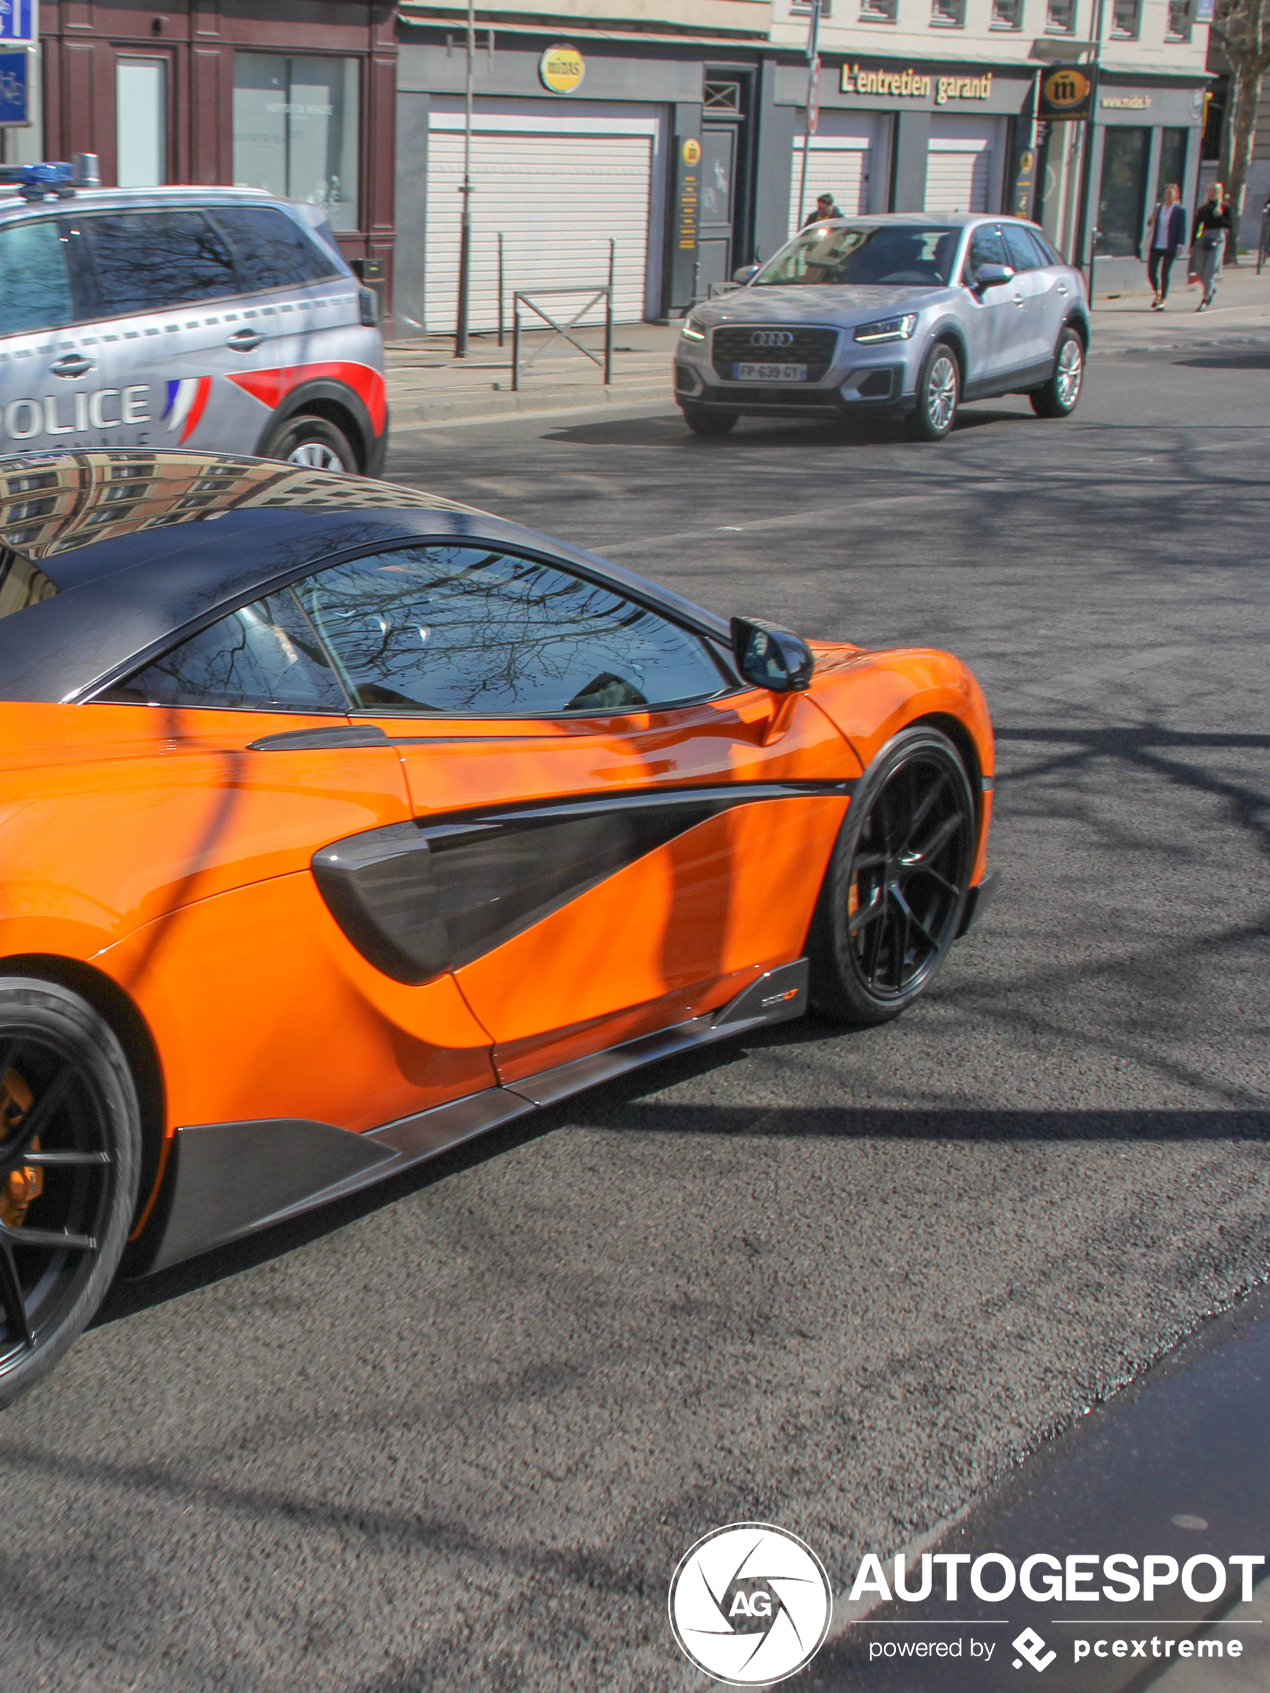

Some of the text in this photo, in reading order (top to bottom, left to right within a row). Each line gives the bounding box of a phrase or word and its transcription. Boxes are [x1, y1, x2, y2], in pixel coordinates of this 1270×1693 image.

[841, 63, 994, 105] L'entretien garanti
[1100, 94, 1153, 110] www.midas.fr
